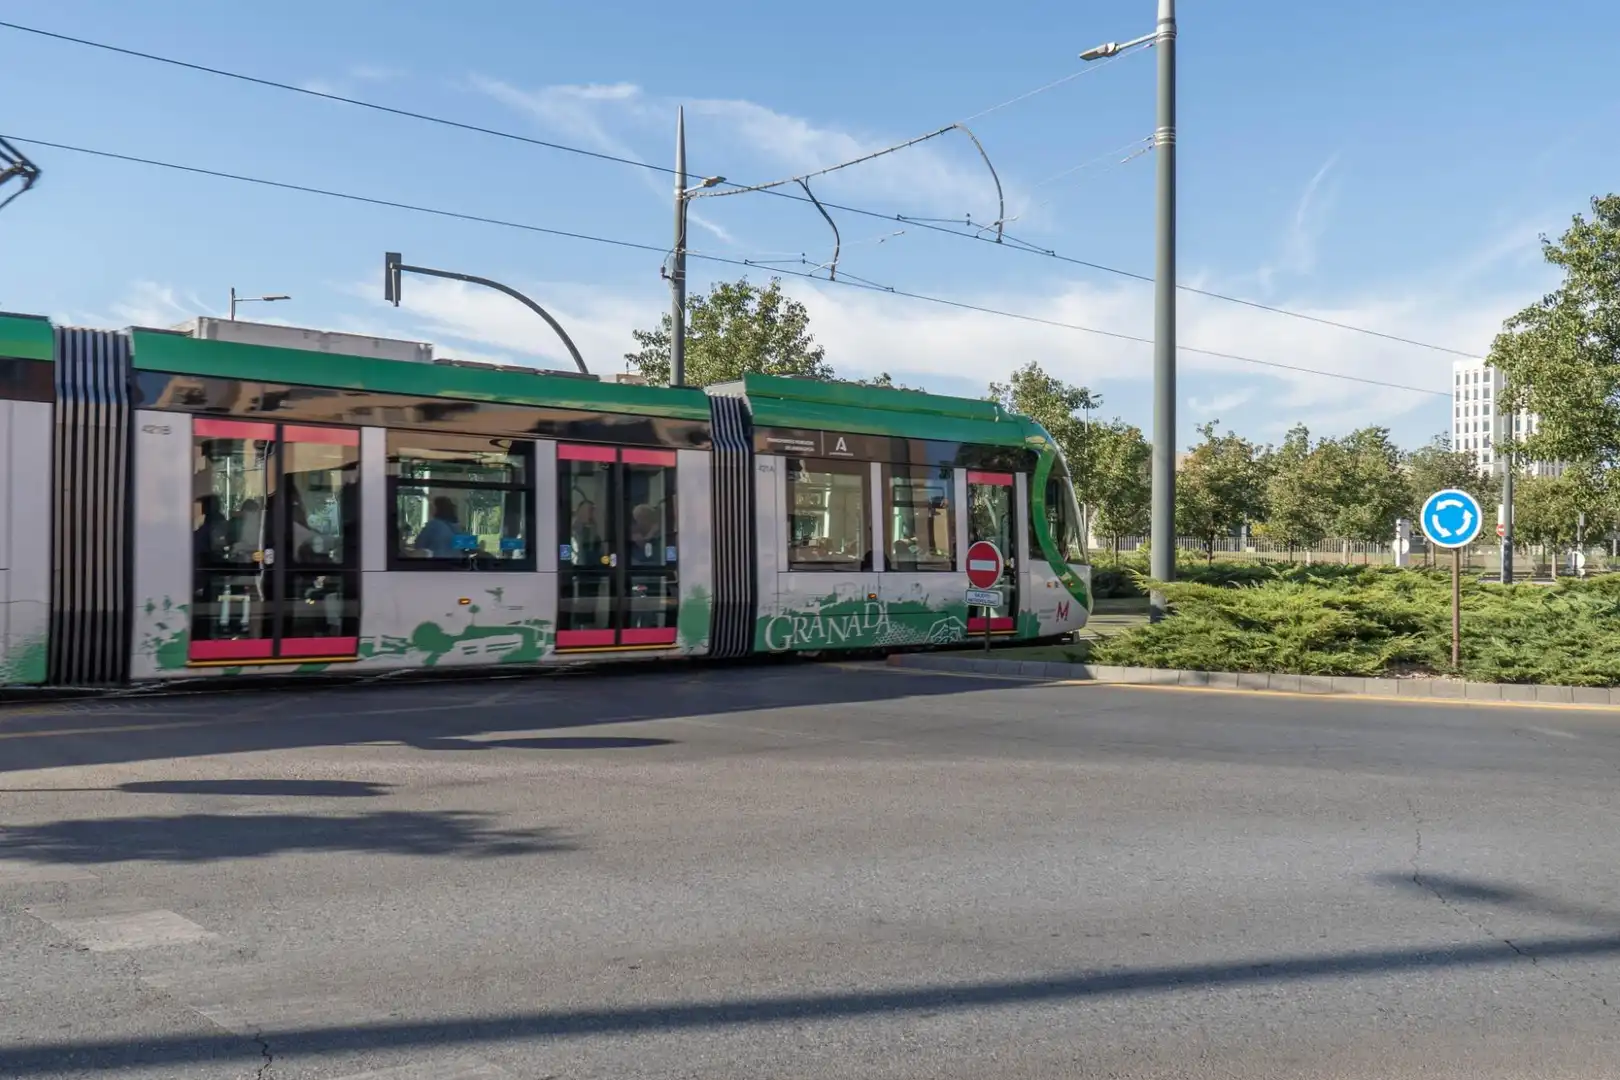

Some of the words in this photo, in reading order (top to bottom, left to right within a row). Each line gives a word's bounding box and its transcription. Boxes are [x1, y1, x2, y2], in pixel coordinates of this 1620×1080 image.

[836, 437, 847, 452] A
[1057, 601, 1069, 622] M
[765, 602, 891, 650] GRANADA
